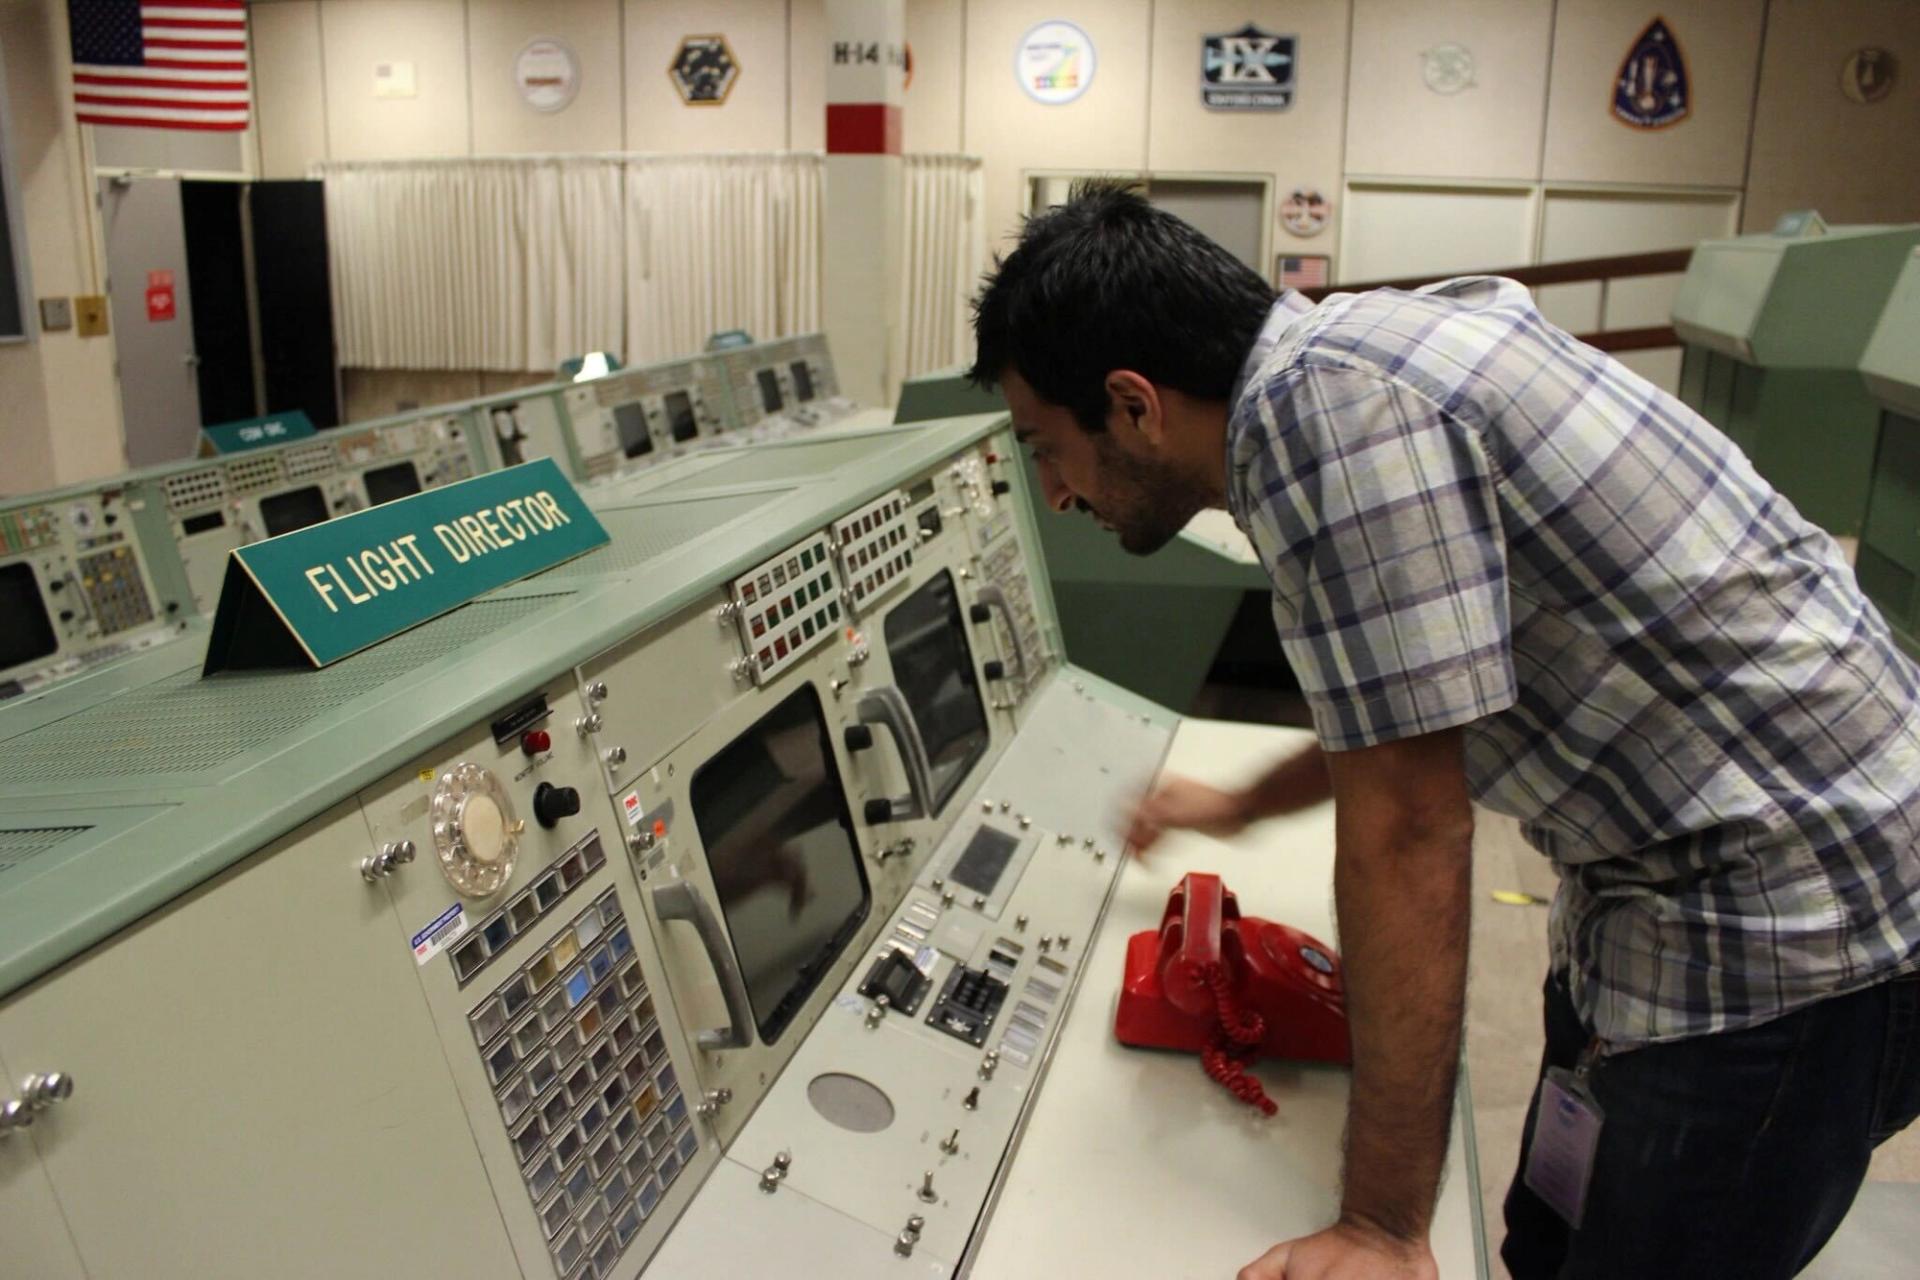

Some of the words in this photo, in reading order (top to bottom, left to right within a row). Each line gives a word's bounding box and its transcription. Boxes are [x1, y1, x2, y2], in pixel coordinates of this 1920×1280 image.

[833, 42, 879, 65] H-14
[305, 534, 434, 612] FLIGHT
[433, 491, 571, 563] DIRECTOR
